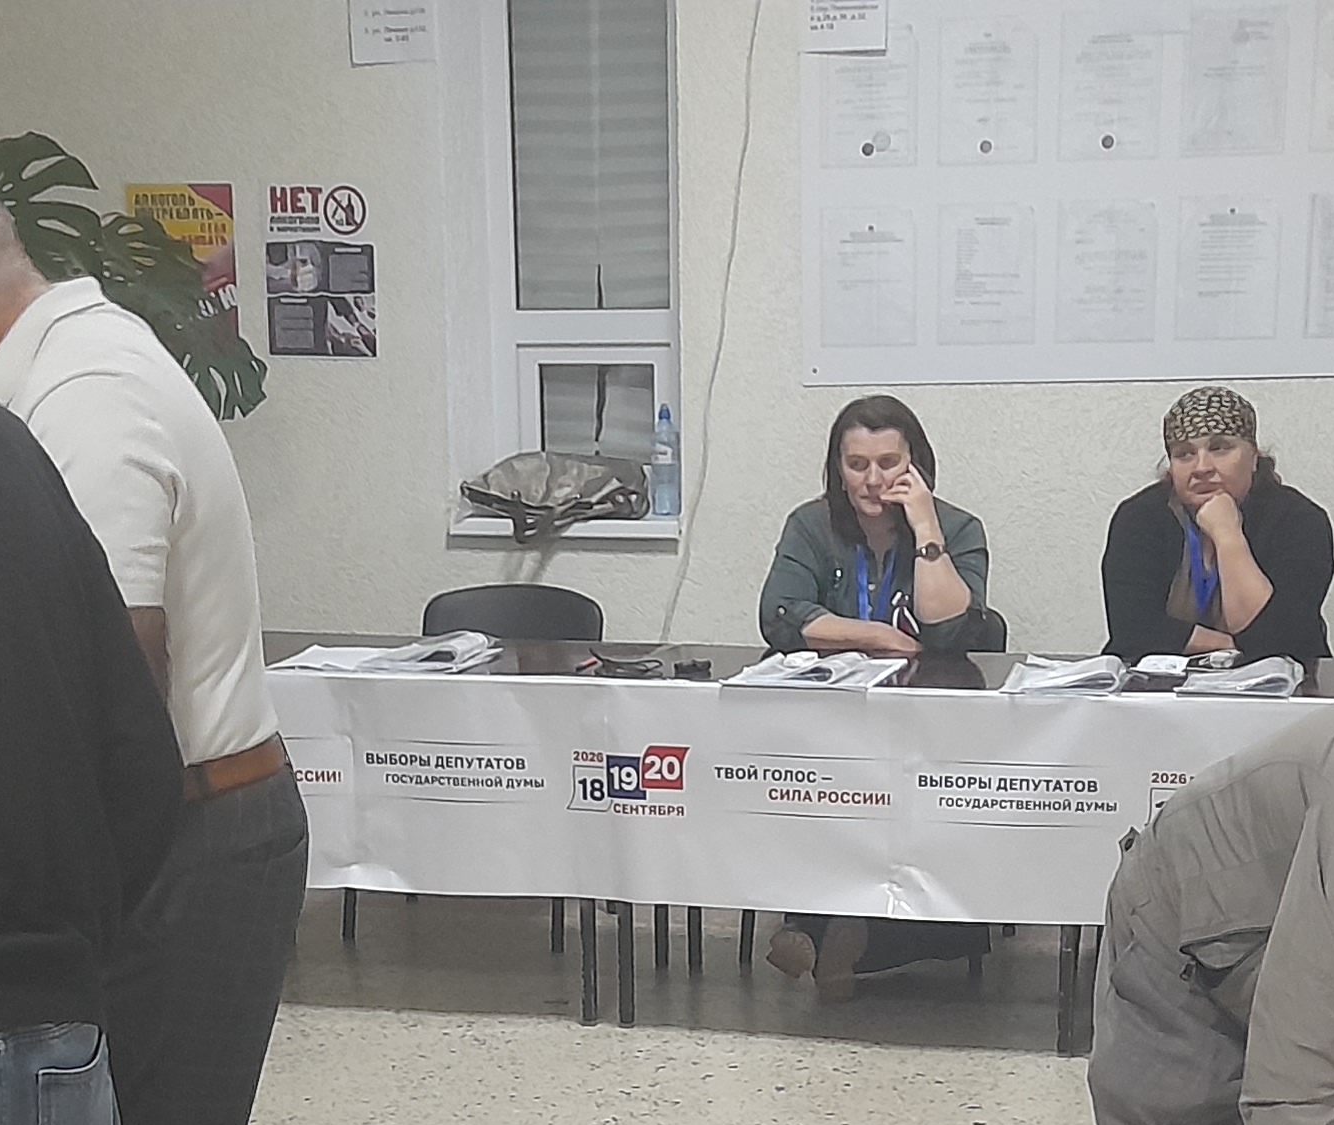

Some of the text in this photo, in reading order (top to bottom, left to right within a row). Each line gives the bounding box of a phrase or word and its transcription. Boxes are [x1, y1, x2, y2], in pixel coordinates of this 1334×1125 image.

[270, 186, 323, 214] НЕТ
[366, 752, 526, 770] ВЫБОРЫ ДЕПУТАТОВ
[573, 751, 604, 762] 2026
[294, 769, 342, 783] ССИИ!
[385, 773, 545, 789] ГОСУДАРСТВЕННОЙ ДУМЫ
[578, 755, 681, 801] 18 19 20
[714, 765, 758, 780] ТВОЙ
[763, 769, 817, 783] ГОЛОС
[1151, 772, 1187, 785] 2026
[918, 775, 1098, 793] ВЫБОРЫ ДЕПУТАТОВ
[768, 788, 892, 805] СИЛА РОССИИ!
[613, 803, 685, 816] СЕНТЯБРЯ
[938, 797, 1117, 813] ГОСУДАРСТВЕННОЙ ДУМЫ
